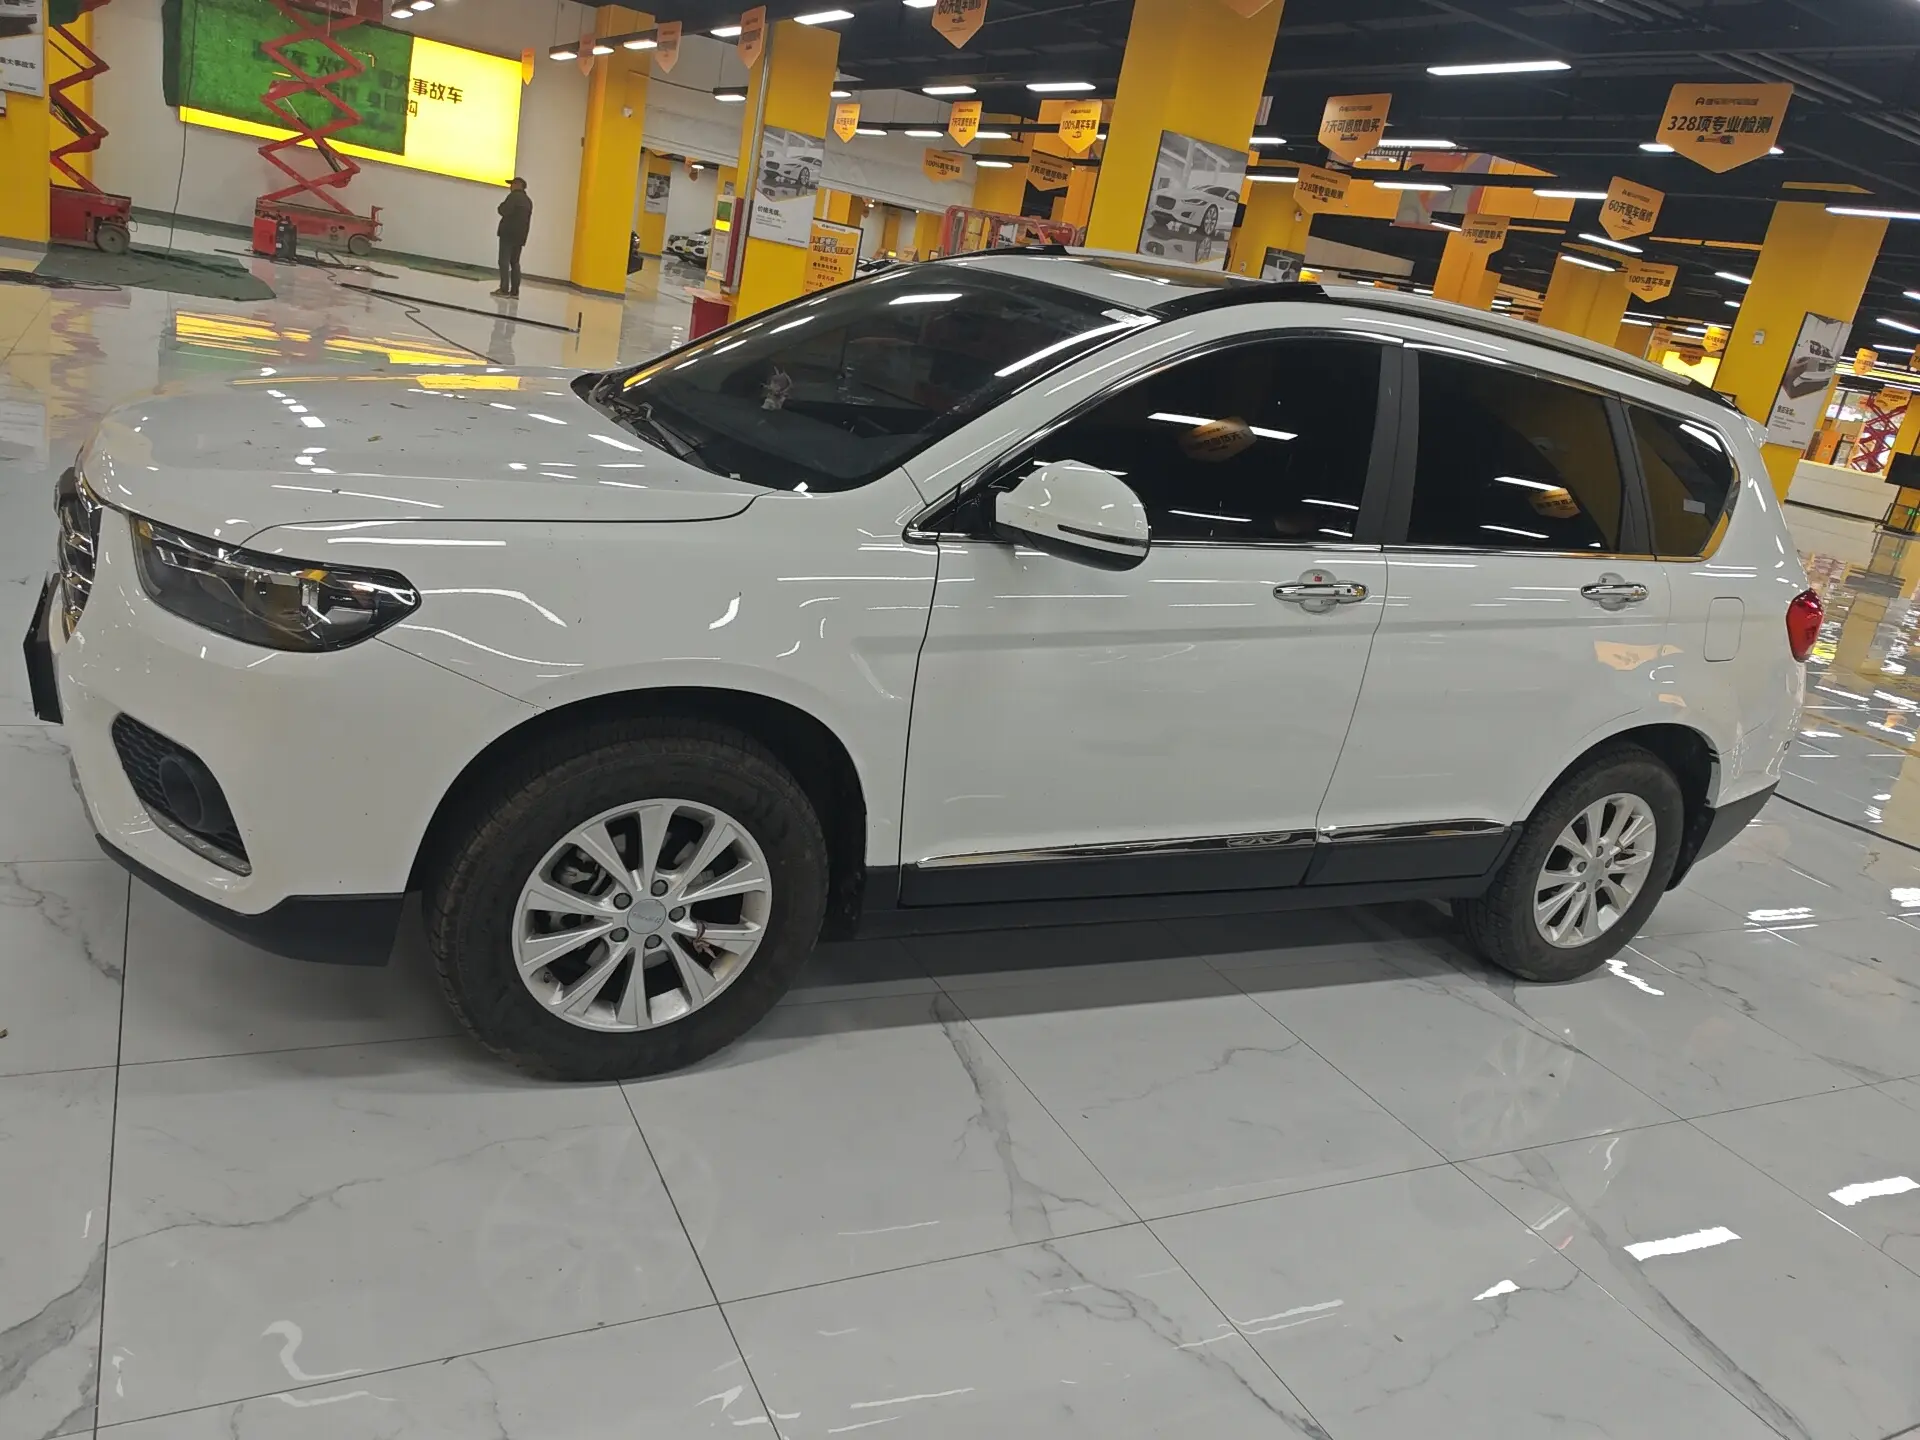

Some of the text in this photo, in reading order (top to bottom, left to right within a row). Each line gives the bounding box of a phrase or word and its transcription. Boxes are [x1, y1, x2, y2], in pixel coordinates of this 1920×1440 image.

[1323, 118, 1381, 133] 7天可退放心买
[1667, 115, 1773, 134] 328项专业检测
[1300, 181, 1345, 200] 328项专业检测
[1608, 200, 1654, 222] 60天整车保修
[1628, 275, 1672, 288] 100%真实车源
